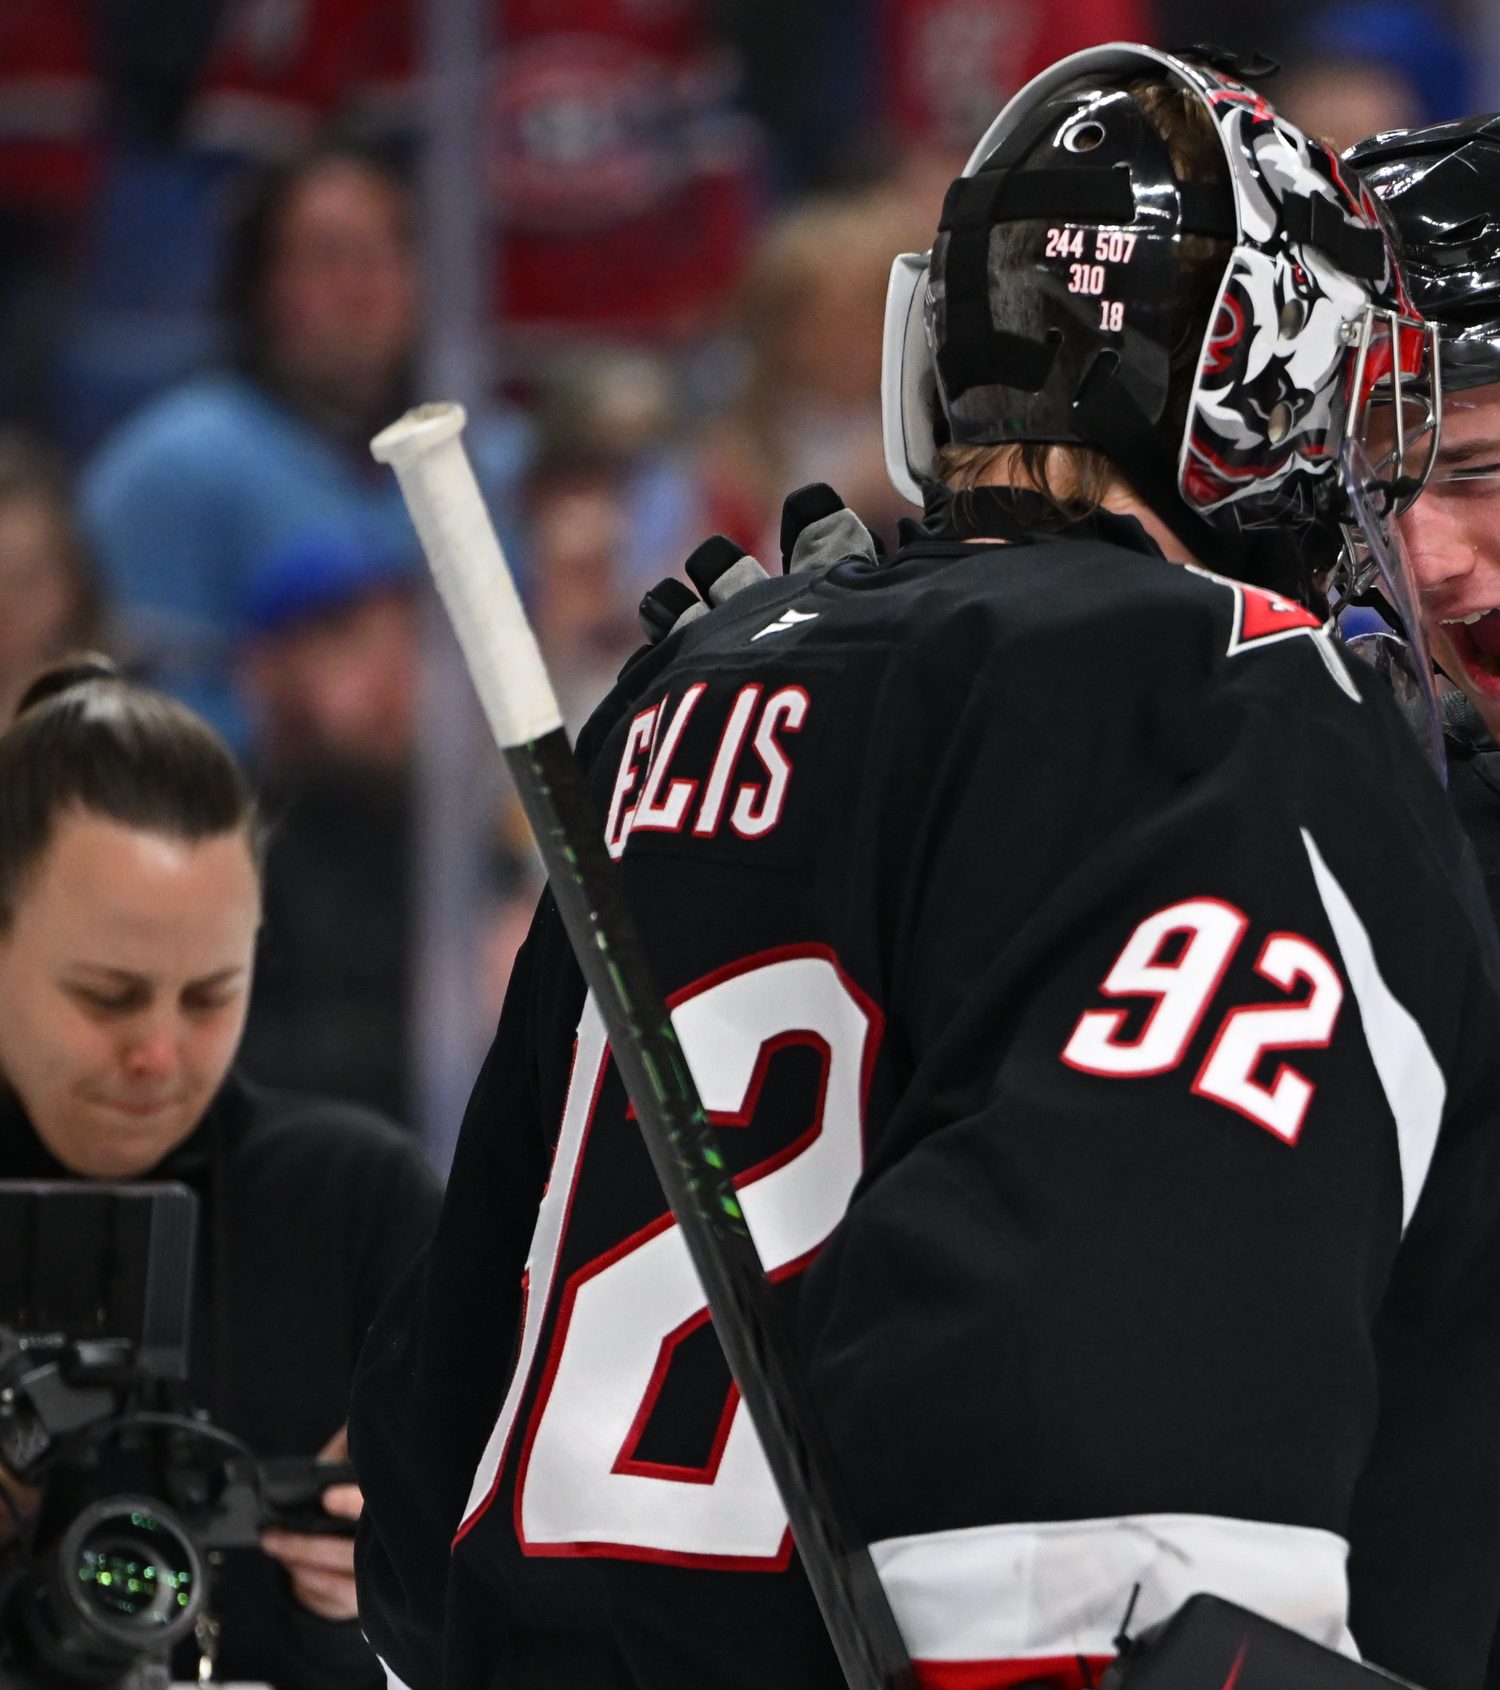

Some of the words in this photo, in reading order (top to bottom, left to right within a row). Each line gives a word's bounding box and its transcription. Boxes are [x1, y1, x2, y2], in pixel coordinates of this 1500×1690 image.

[1045, 228, 1084, 259] 244
[1095, 231, 1137, 264] 507
[1068, 263, 1105, 295] 310
[1099, 300, 1124, 332] 18
[604, 682, 811, 863] ELIS
[1059, 895, 1344, 1147] 92
